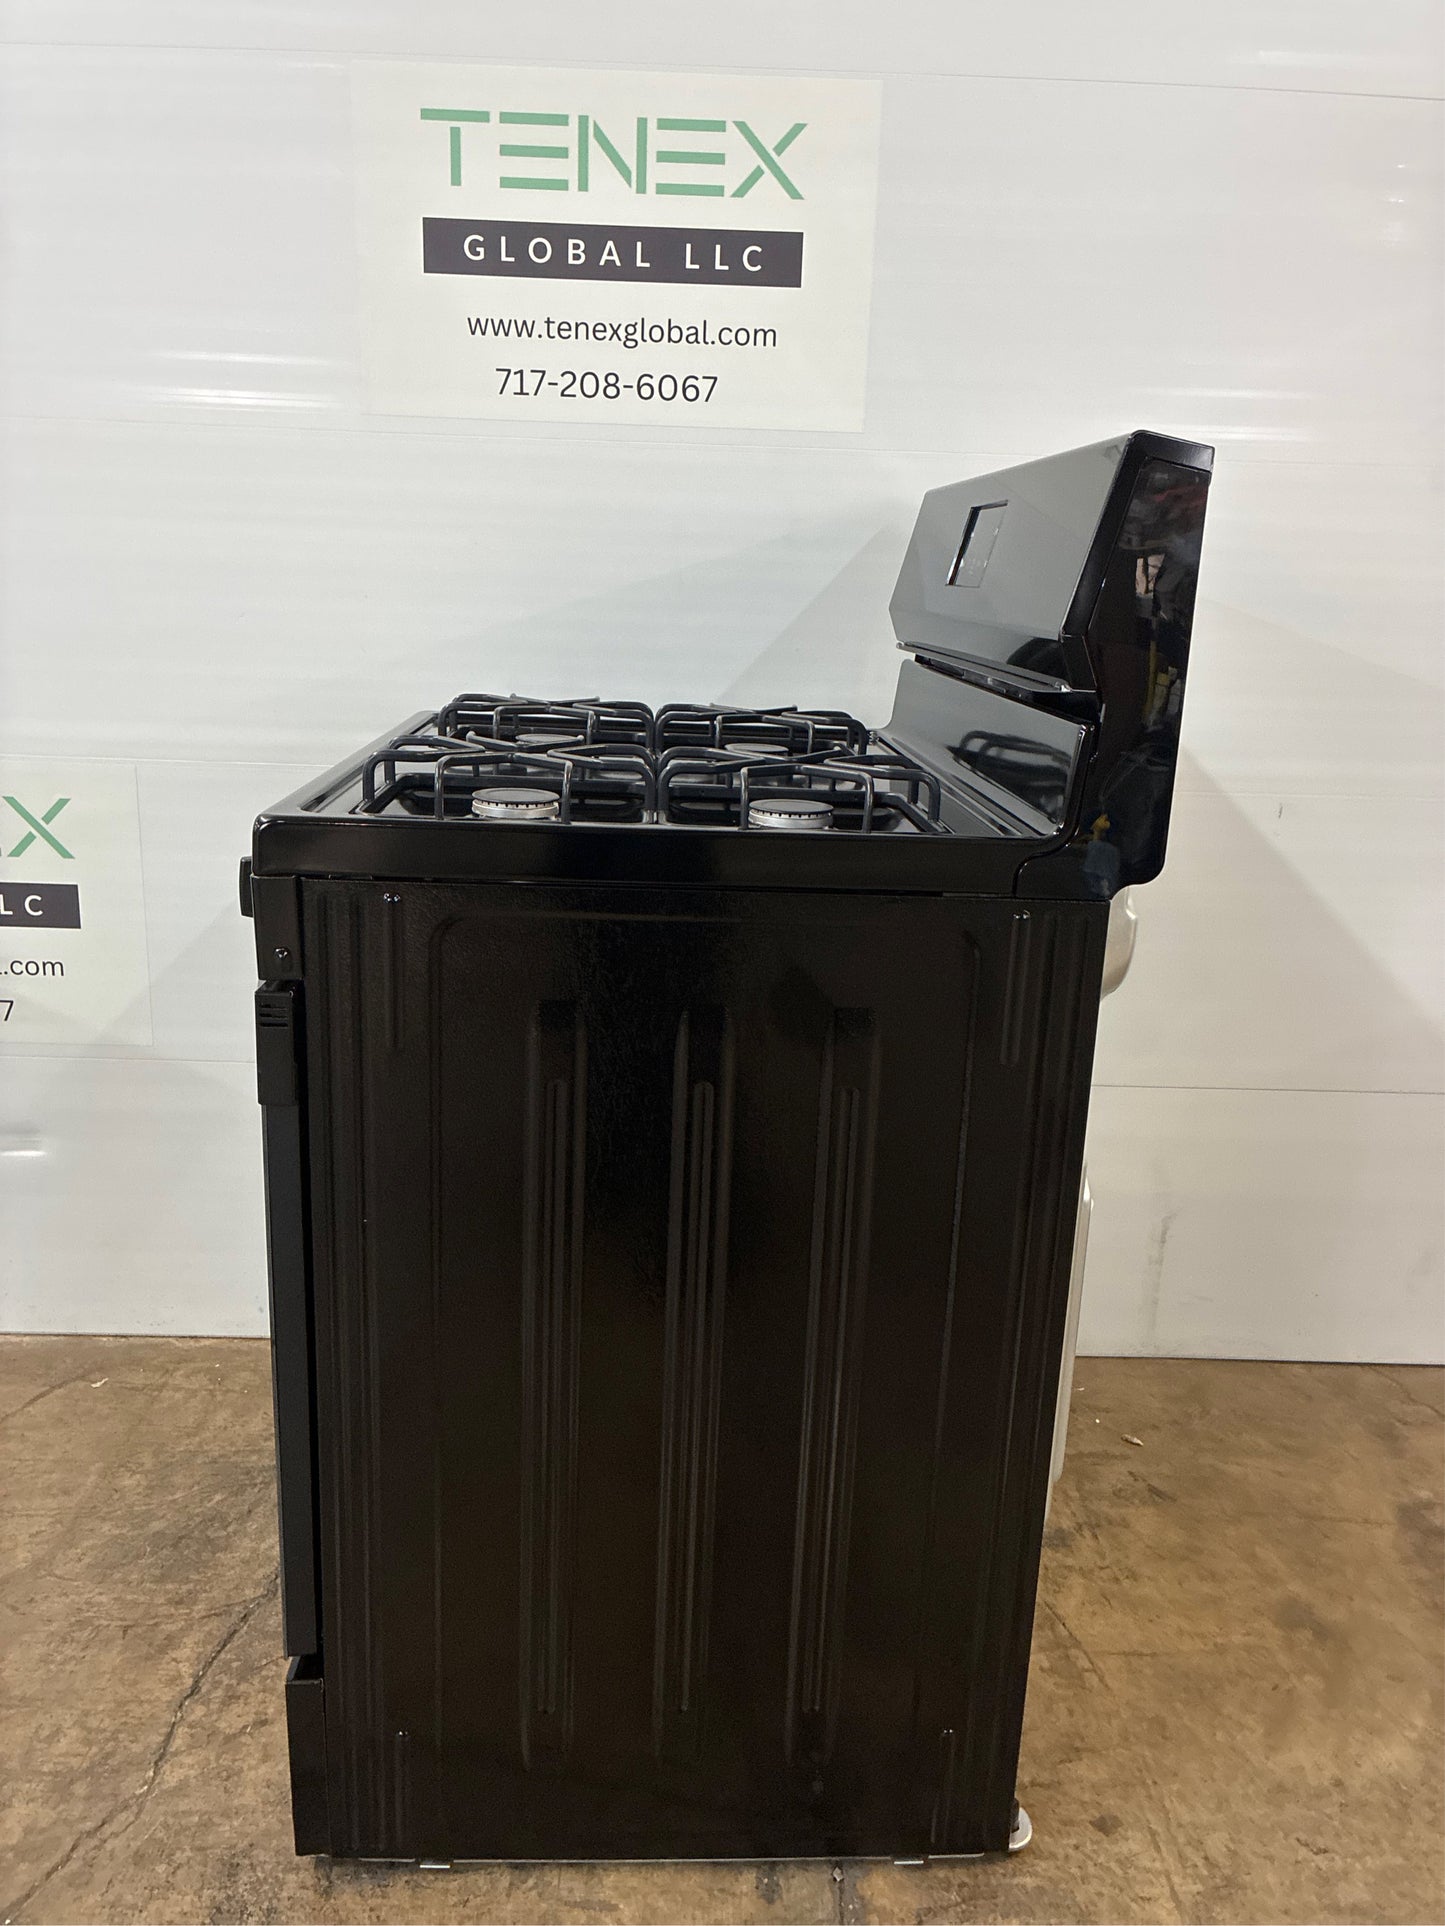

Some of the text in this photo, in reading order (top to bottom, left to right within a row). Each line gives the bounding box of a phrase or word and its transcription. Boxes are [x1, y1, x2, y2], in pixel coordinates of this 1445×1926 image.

[420, 108, 807, 200] TENEX
[463, 234, 763, 272] GLOBAL LLC
[467, 316, 777, 348] www.tenexglobal.com
[495, 367, 718, 402] 717-208-6067
[0, 796, 75, 859] X
[0, 960, 64, 977] .com
